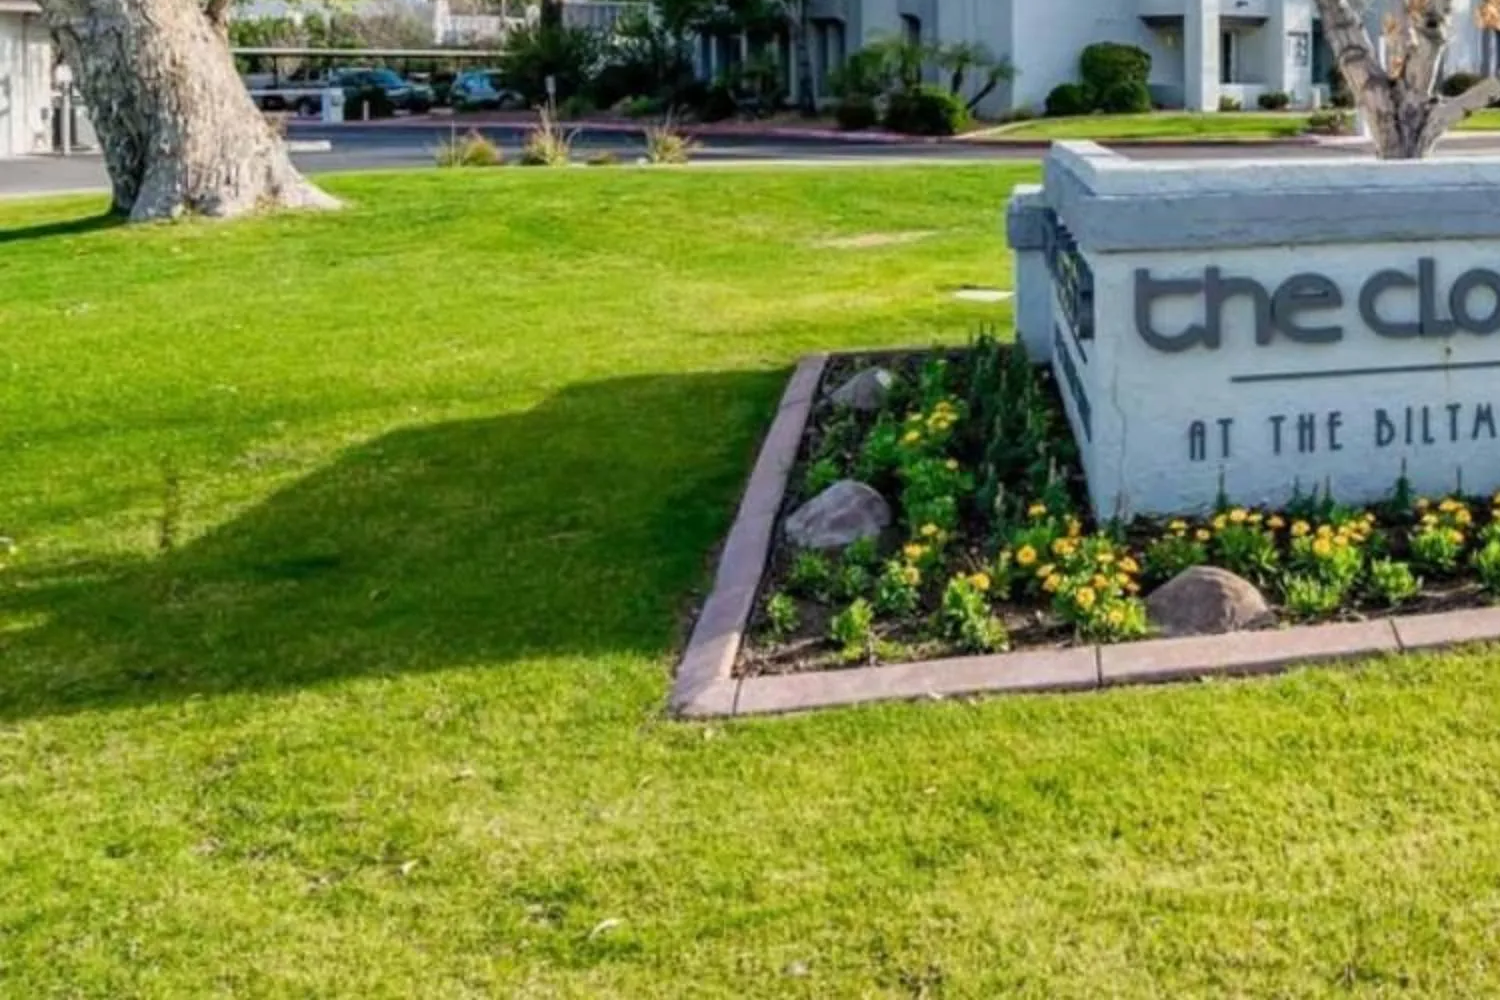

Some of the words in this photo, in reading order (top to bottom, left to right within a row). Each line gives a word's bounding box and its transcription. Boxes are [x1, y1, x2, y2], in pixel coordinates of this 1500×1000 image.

[1135, 265, 1343, 352] the
[1189, 418, 1234, 461] AT
[1268, 410, 1343, 456] THE
